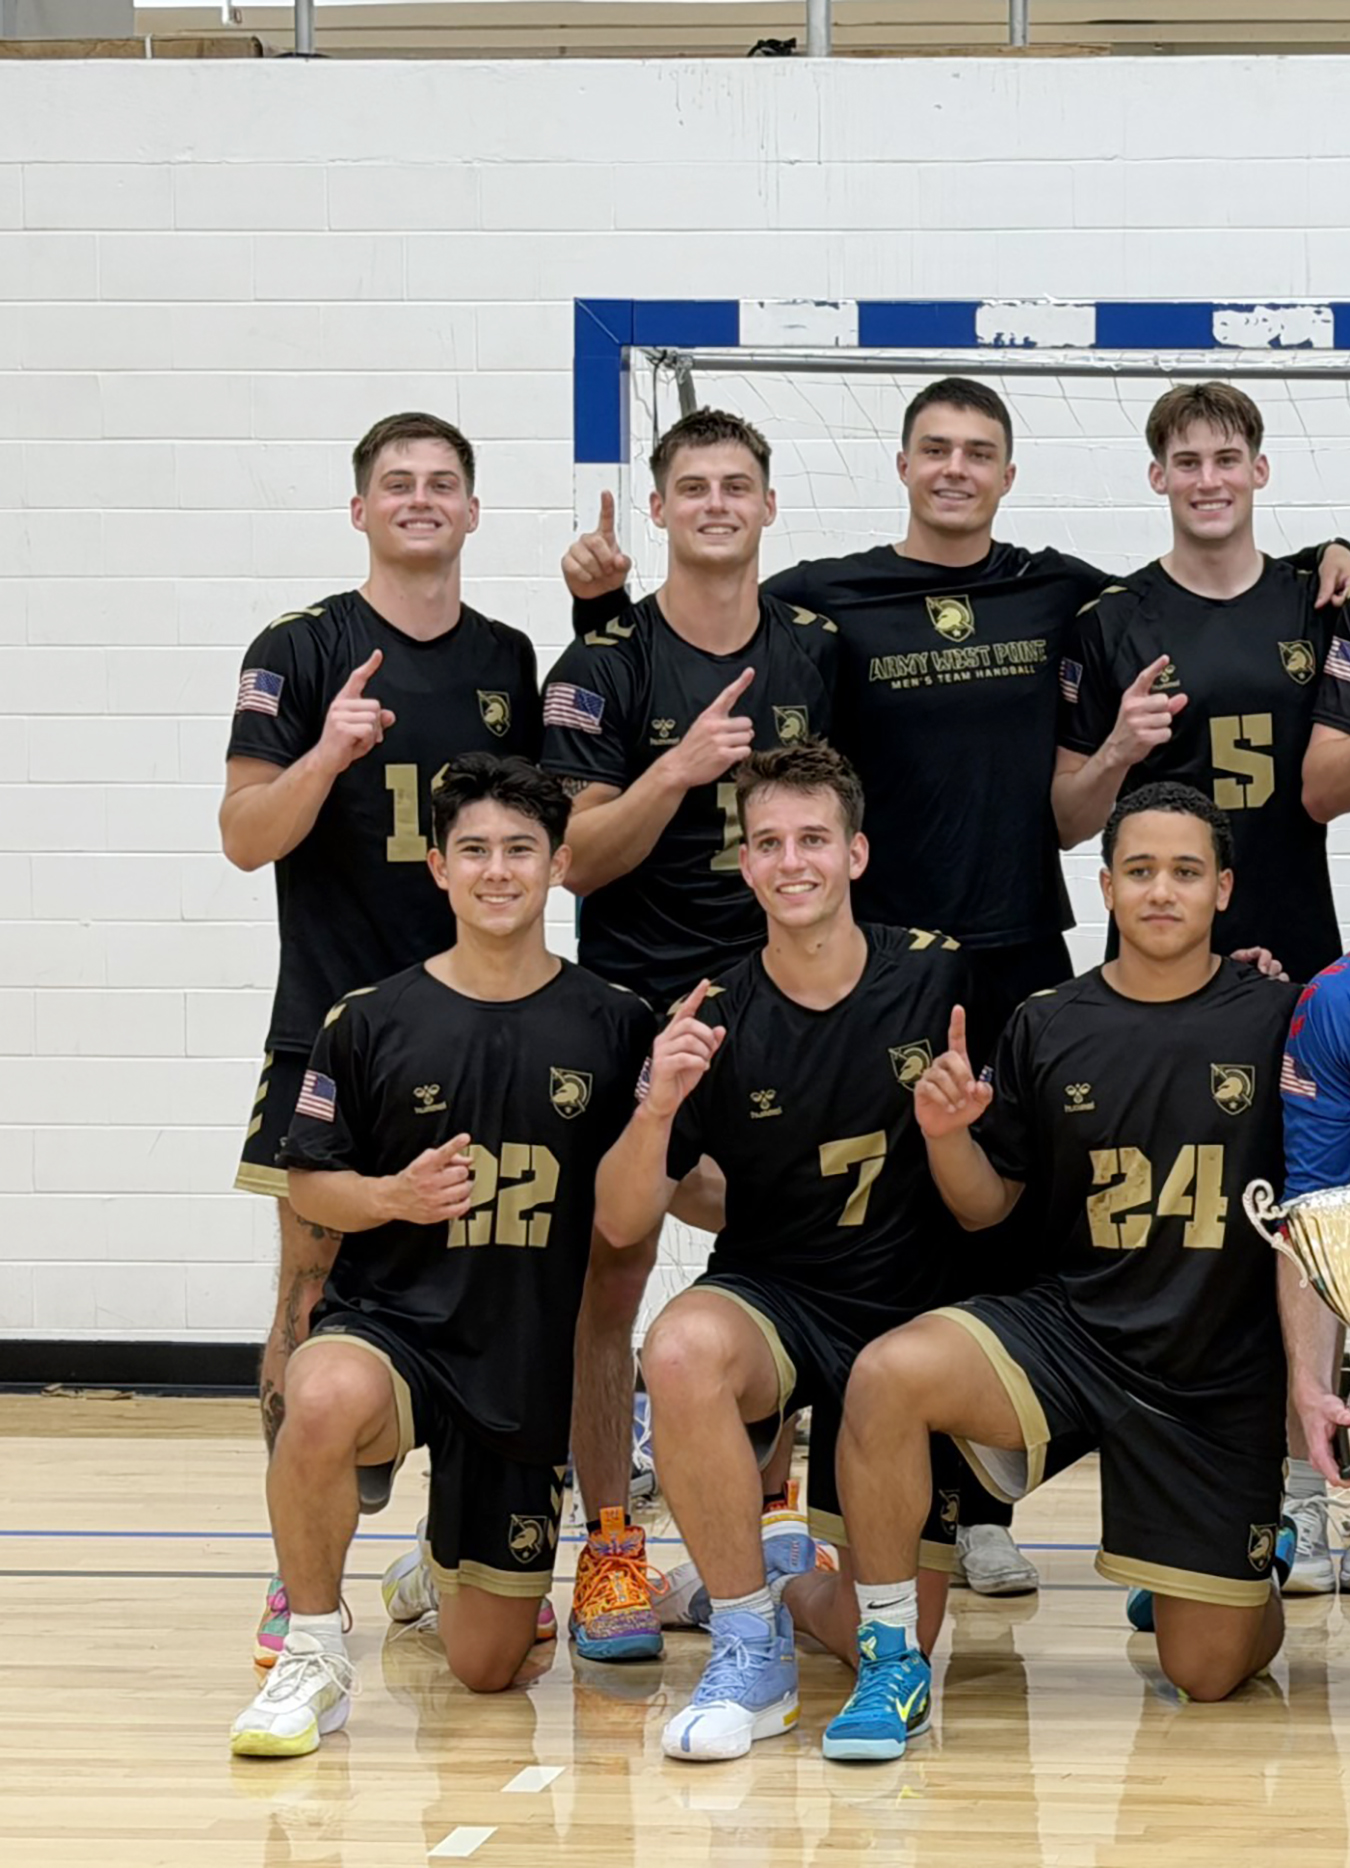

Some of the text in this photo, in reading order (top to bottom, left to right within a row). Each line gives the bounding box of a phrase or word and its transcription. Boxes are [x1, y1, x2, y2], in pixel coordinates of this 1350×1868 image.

[868, 639, 1048, 682] ARMY WEST POINT
[891, 664, 1036, 689] MEN'S TEAM HANDBALL
[1209, 712, 1275, 809] 5
[447, 1141, 561, 1249] 22
[818, 1129, 887, 1227] 7
[1086, 1143, 1229, 1251] 24
